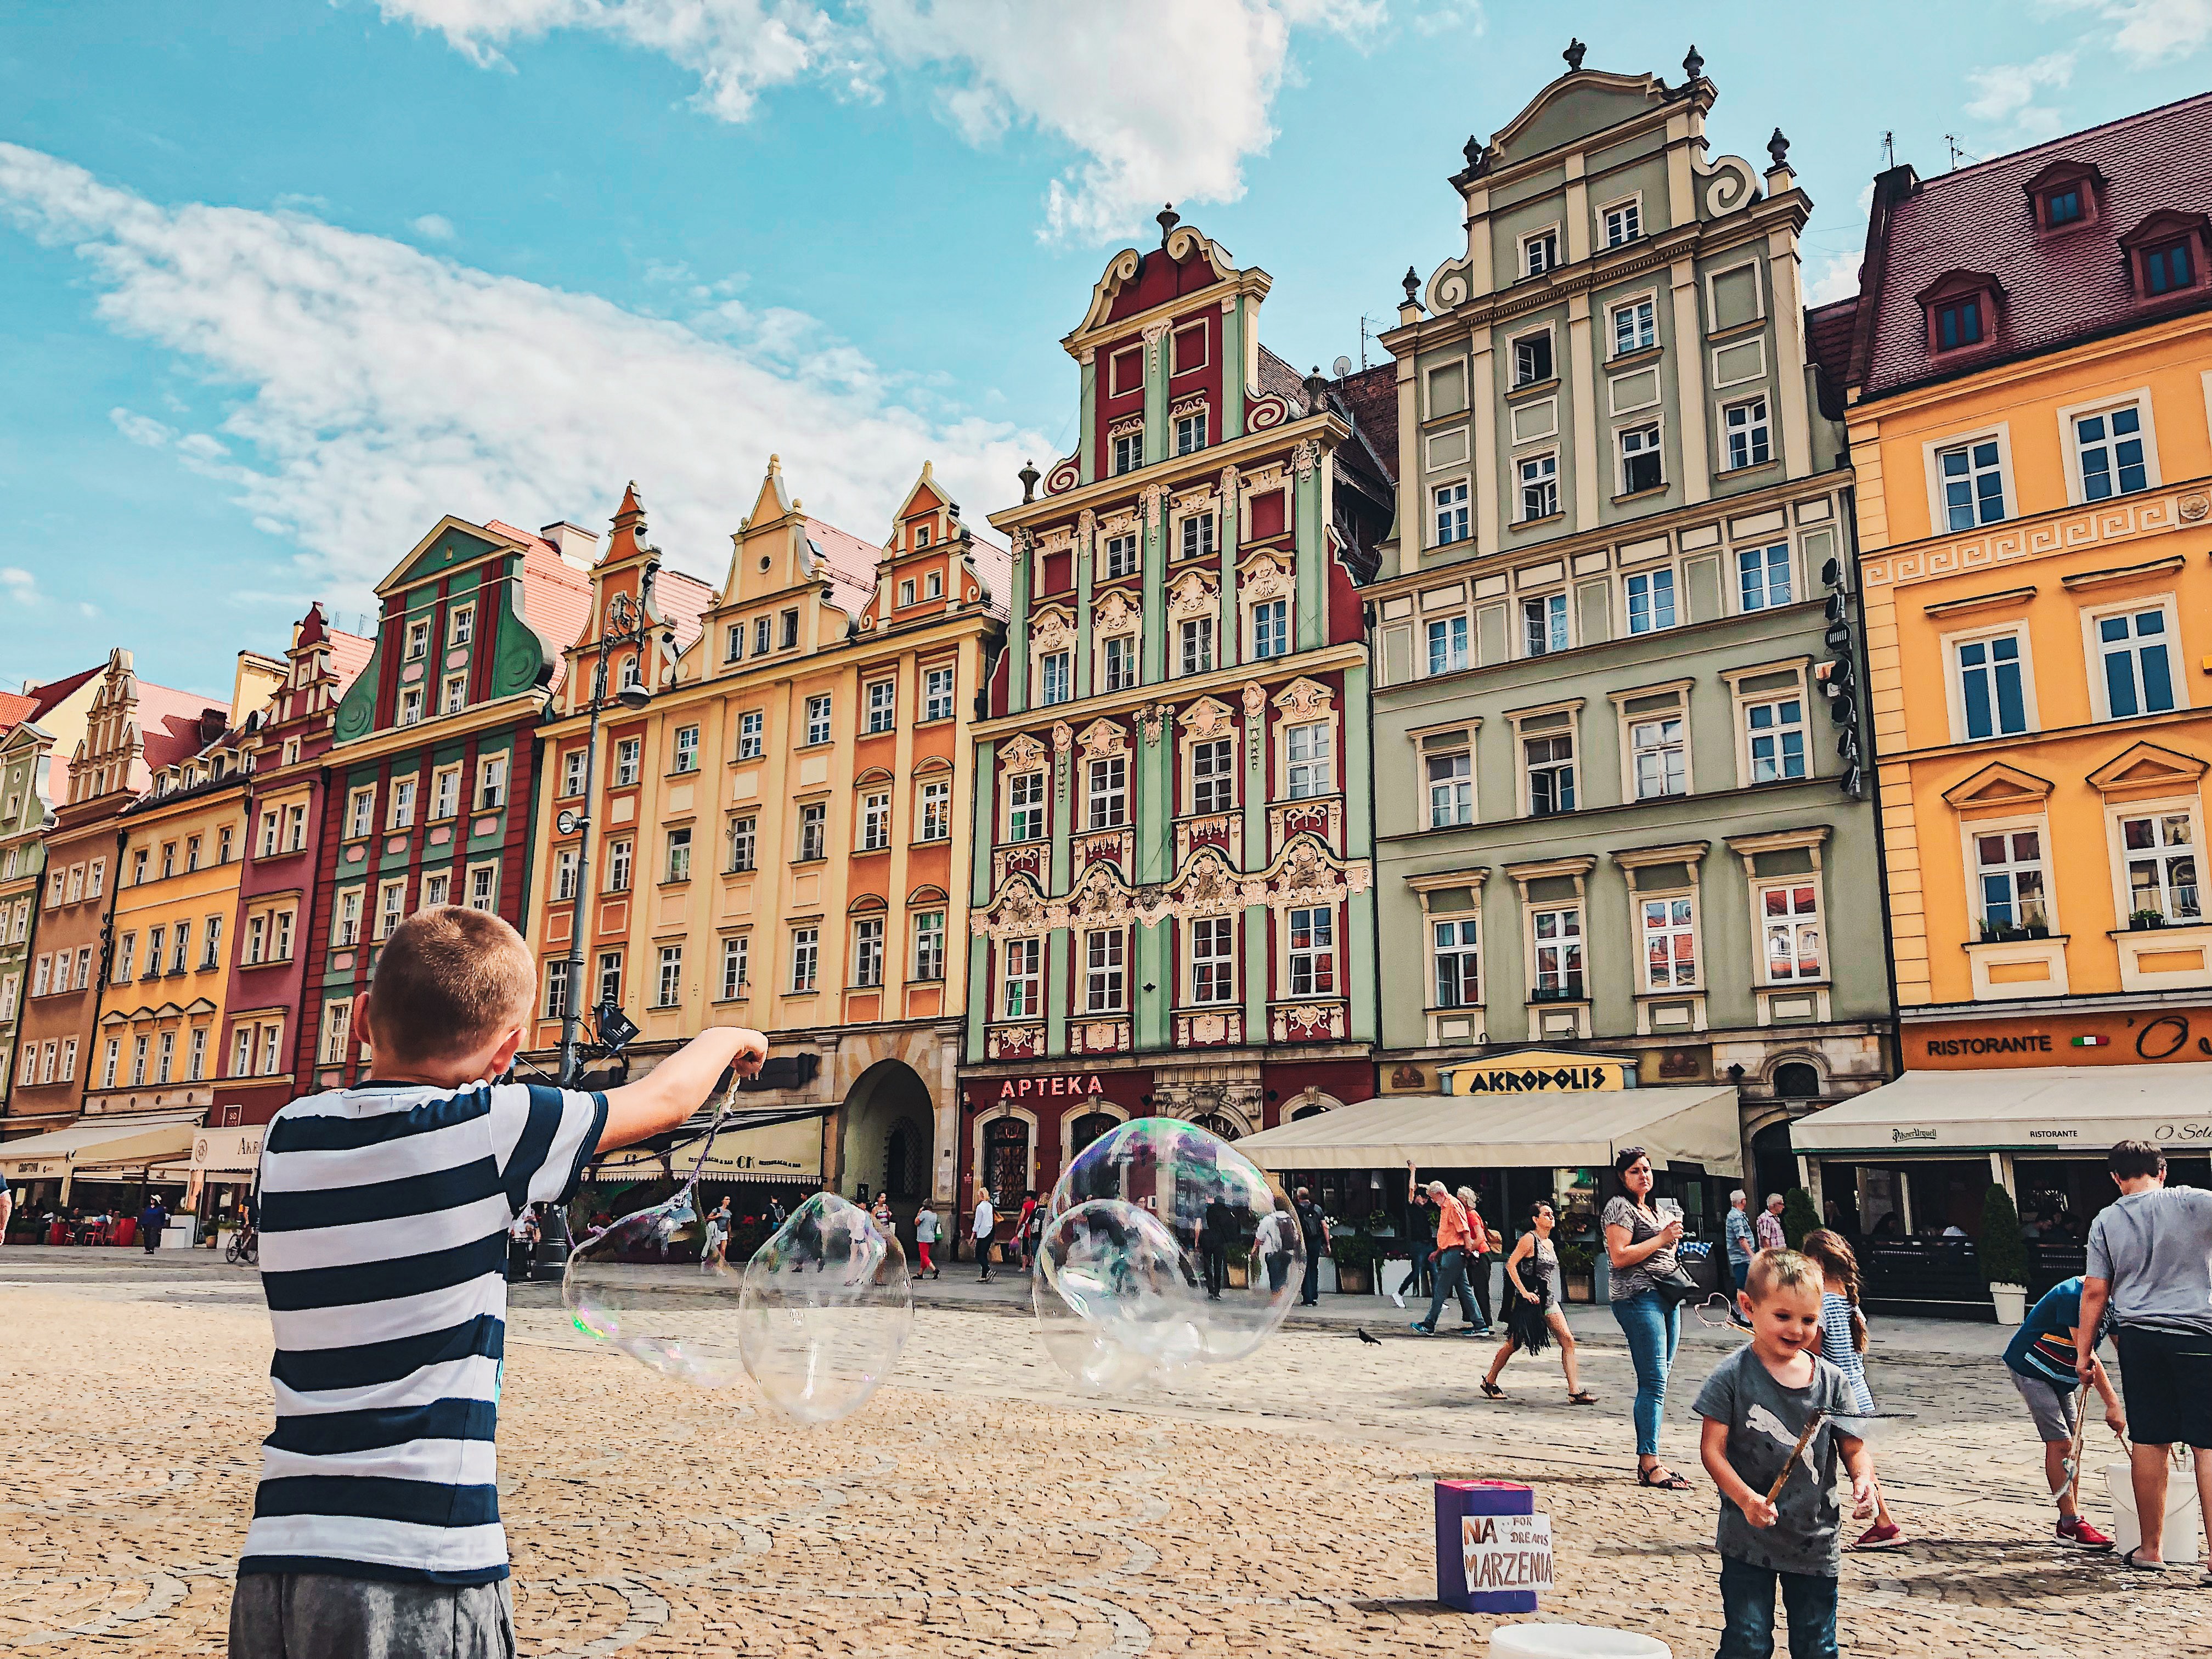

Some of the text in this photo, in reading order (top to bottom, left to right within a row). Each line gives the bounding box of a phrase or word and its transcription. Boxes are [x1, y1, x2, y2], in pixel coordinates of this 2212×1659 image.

[1927, 1035, 2053, 1056] RISTORANTE
[1001, 1076, 1103, 1098] APTEKA
[1470, 1066, 1606, 1093] AKROPOLIS
[736, 1155, 755, 1169] CK
[1464, 1517, 1498, 1545] NA
[1513, 1516, 1532, 1527] FOR
[1510, 1531, 1549, 1546] DREAMS
[1465, 1551, 1553, 1588] MARZENIA
